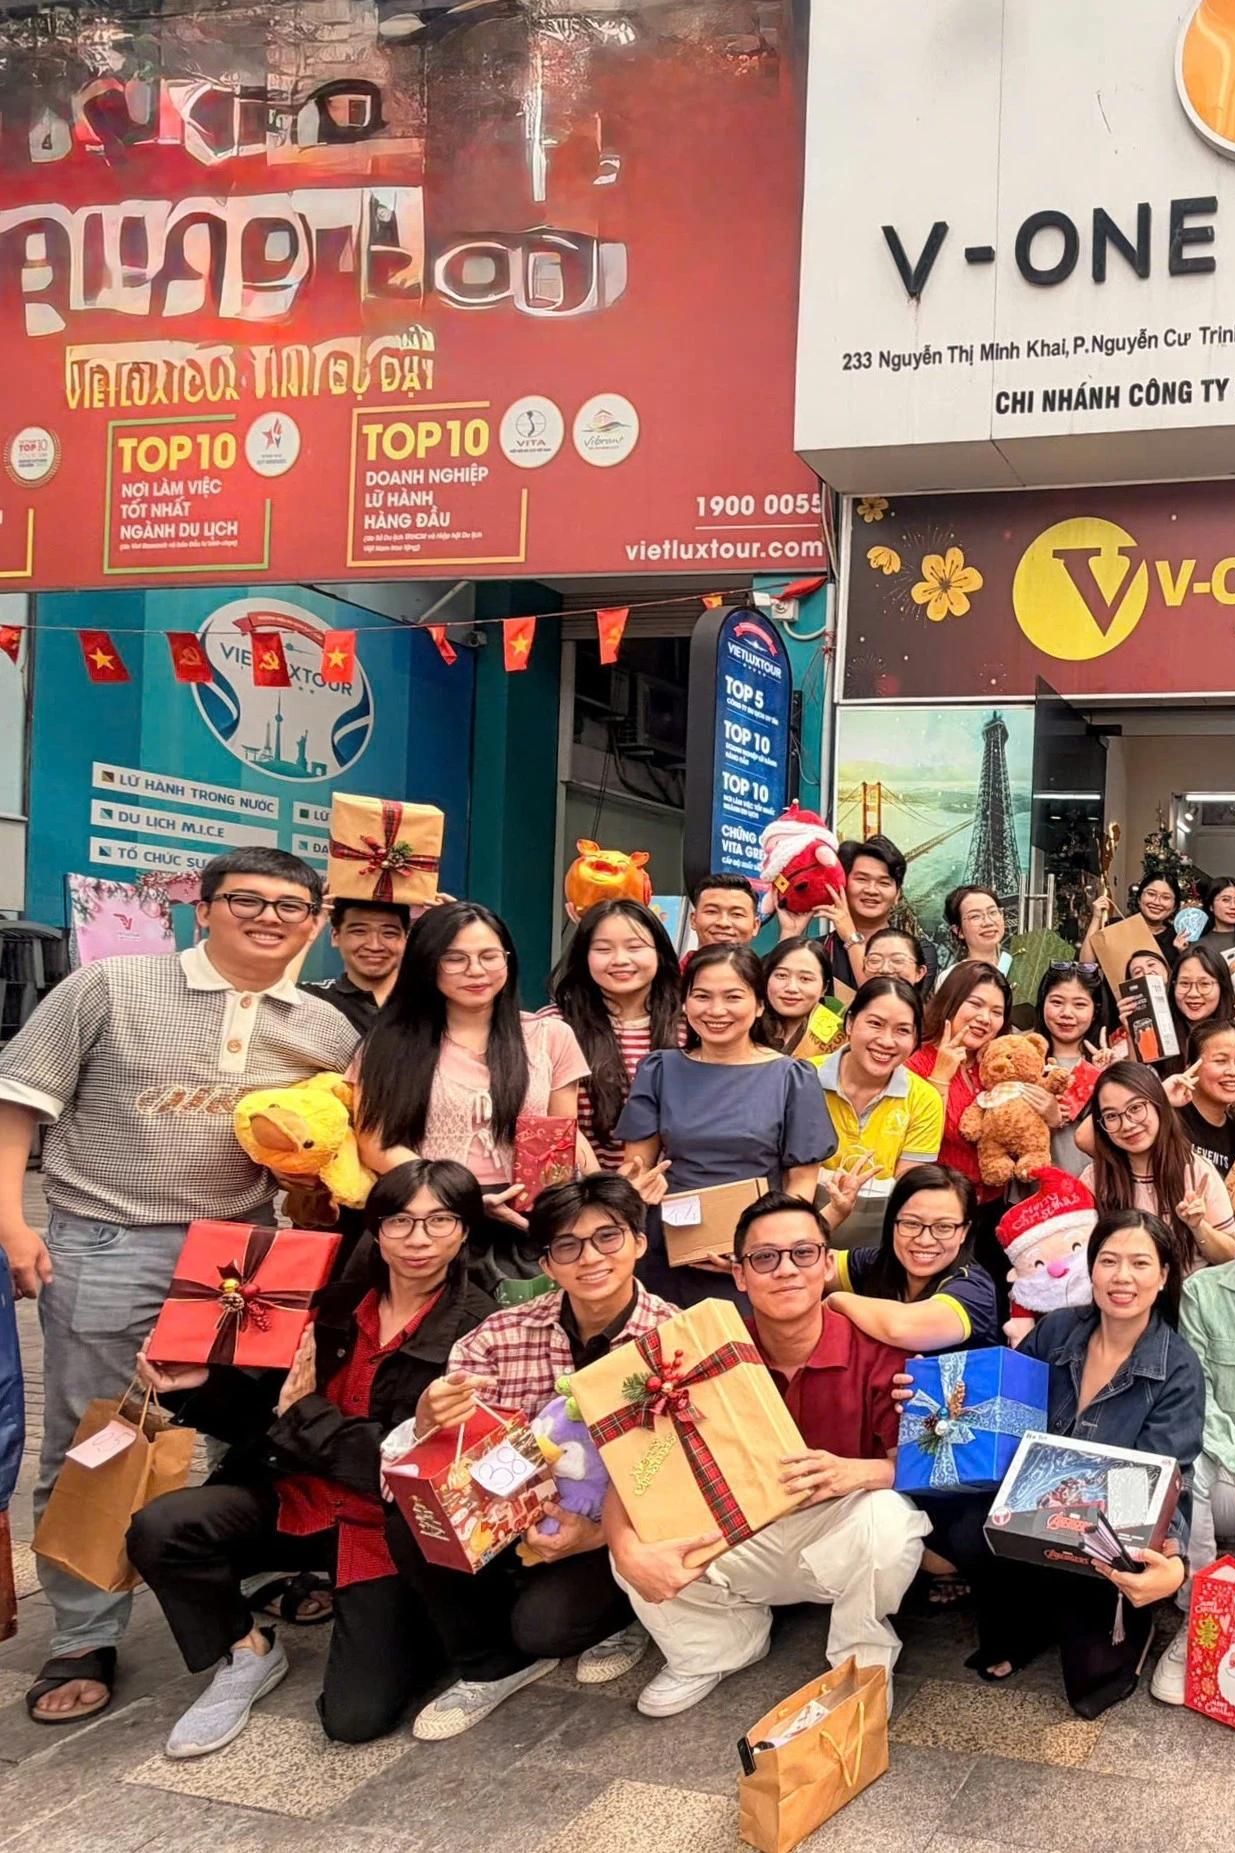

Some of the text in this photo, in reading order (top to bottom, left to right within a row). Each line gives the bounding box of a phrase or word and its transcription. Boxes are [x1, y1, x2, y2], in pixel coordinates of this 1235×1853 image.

[882, 195, 1219, 298] V-ONE
[842, 353, 872, 370] 233
[879, 345, 942, 371] Nguyễn
[947, 344, 974, 366] Thị
[980, 341, 1020, 361] Minh
[1027, 338, 1070, 359] Khai,
[1164, 329, 1191, 347] Cư
[995, 391, 1033, 414] CHI
[1042, 382, 1120, 412] NHÁNH
[1129, 378, 1192, 407] CÔNG
[1201, 378, 1230, 402] TY
[363, 418, 489, 461] TOP 10
[118, 433, 236, 473] TOP 10
[153, 479, 184, 497] LÀM
[188, 476, 223, 499] VIỆC
[365, 463, 488, 487] DOANH NGHIỆP
[120, 496, 191, 519] TỐT NHẤT
[387, 487, 434, 507] HÀNH
[697, 493, 822, 516] 1900 0055
[364, 504, 451, 530] HÀNG ĐẦU
[120, 519, 238, 542] NGÀNH DU LỊCH
[626, 539, 824, 560] vietluxtour.com
[728, 642, 781, 678] VIETLUXTOUR
[725, 675, 764, 709] TOP 5
[724, 720, 770, 755] TOP 10
[145, 777, 184, 797] HÀNH
[190, 787, 235, 806] TRONG
[240, 797, 274, 813] NƯỚC
[722, 771, 768, 803] TOP 10
[118, 811, 140, 824] DU
[146, 817, 175, 833] LỊCH
[144, 850, 181, 866] CHỨC
[722, 839, 743, 855] VITA
